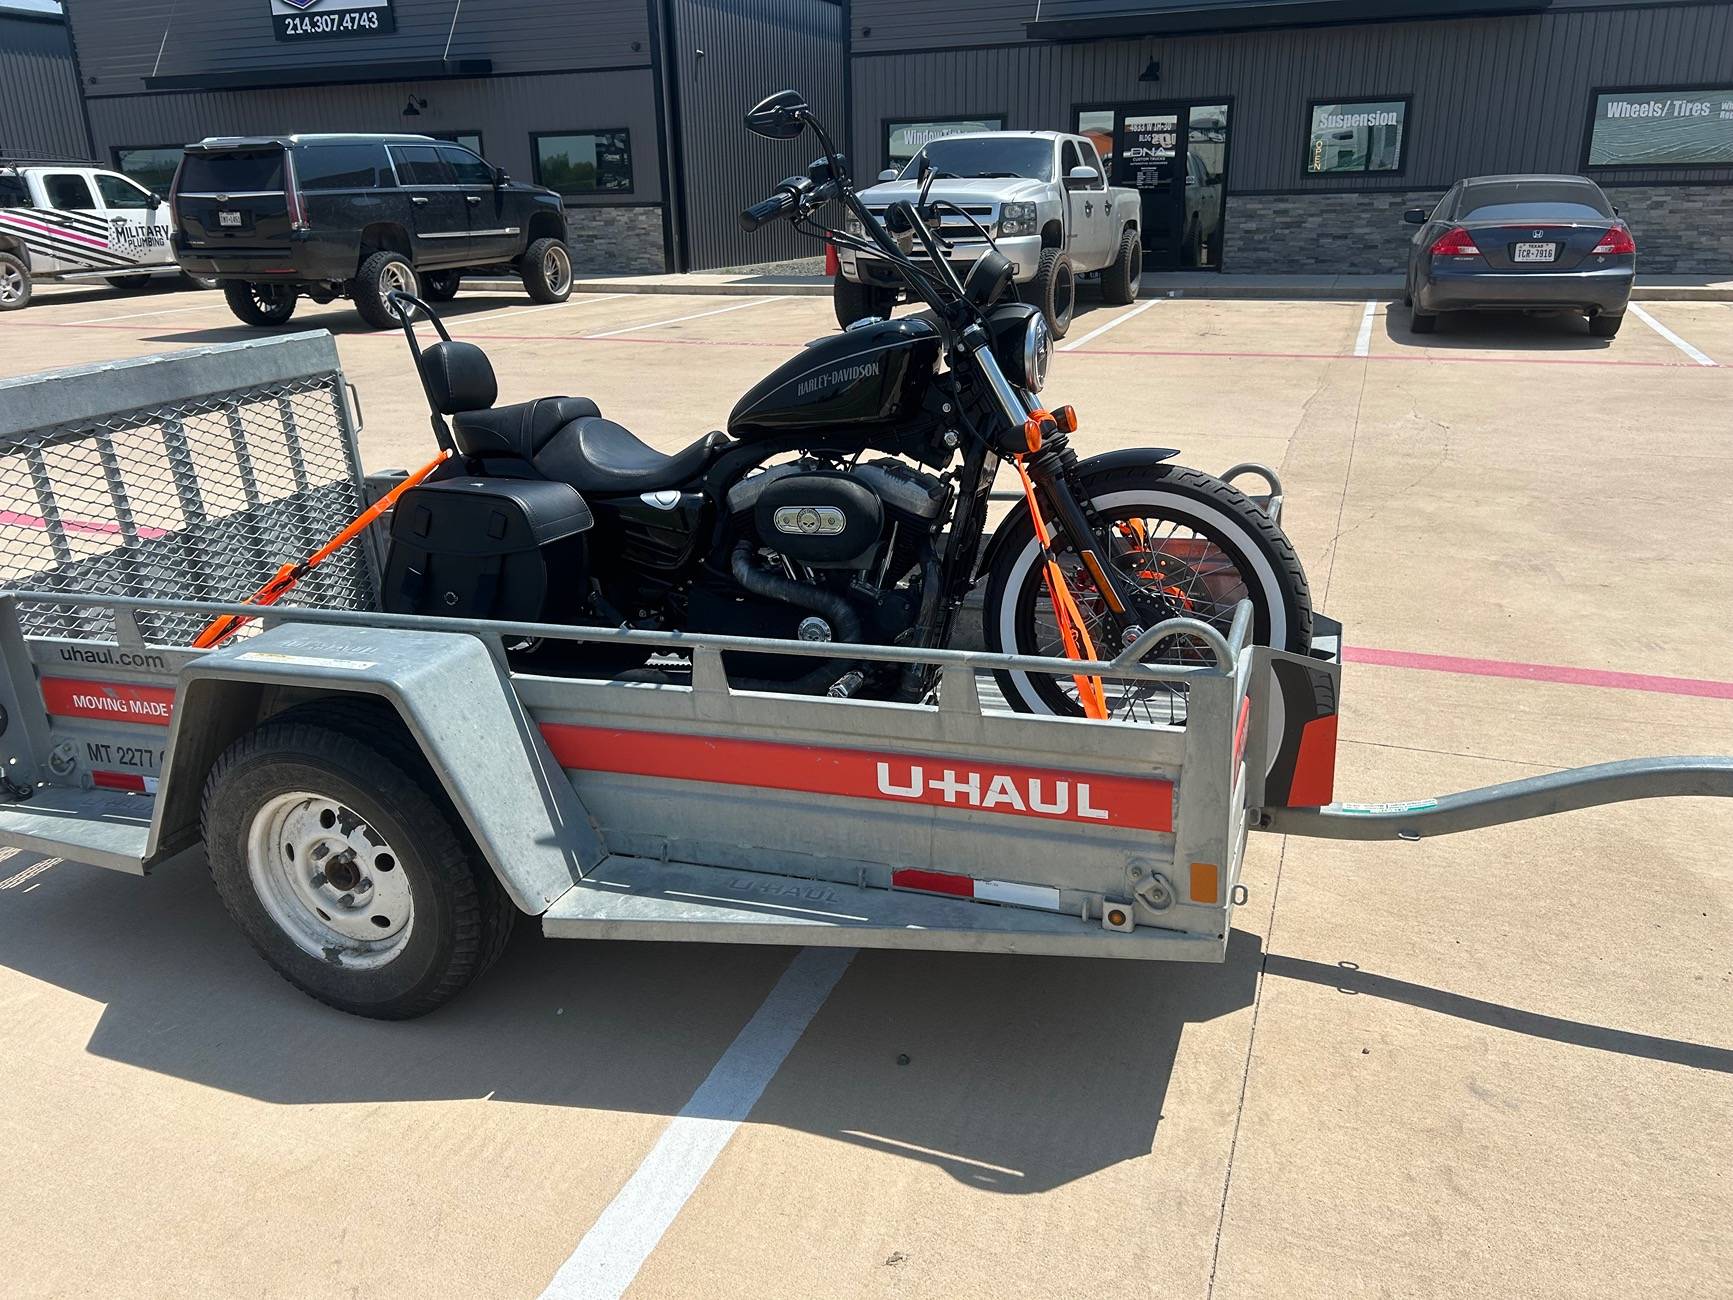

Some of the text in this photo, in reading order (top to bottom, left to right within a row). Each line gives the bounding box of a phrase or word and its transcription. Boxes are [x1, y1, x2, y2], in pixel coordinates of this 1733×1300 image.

[285, 11, 378, 35] 214.307.4743
[1320, 110, 1397, 129] Suspension
[1607, 100, 1711, 118] Wheels/ Tires
[1130, 147, 1166, 157] DNA
[1313, 140, 1323, 171] OPEN
[115, 225, 169, 242] MILITARY
[128, 238, 165, 248] PLUMBING
[797, 362, 879, 396] HARLEY-DAVIDSON
[60, 646, 164, 669] uhaul.com
[72, 694, 169, 717] MOVING MADE
[86, 742, 112, 764] MT
[116, 746, 153, 768] 2277
[876, 762, 1109, 820] U-HAUL
